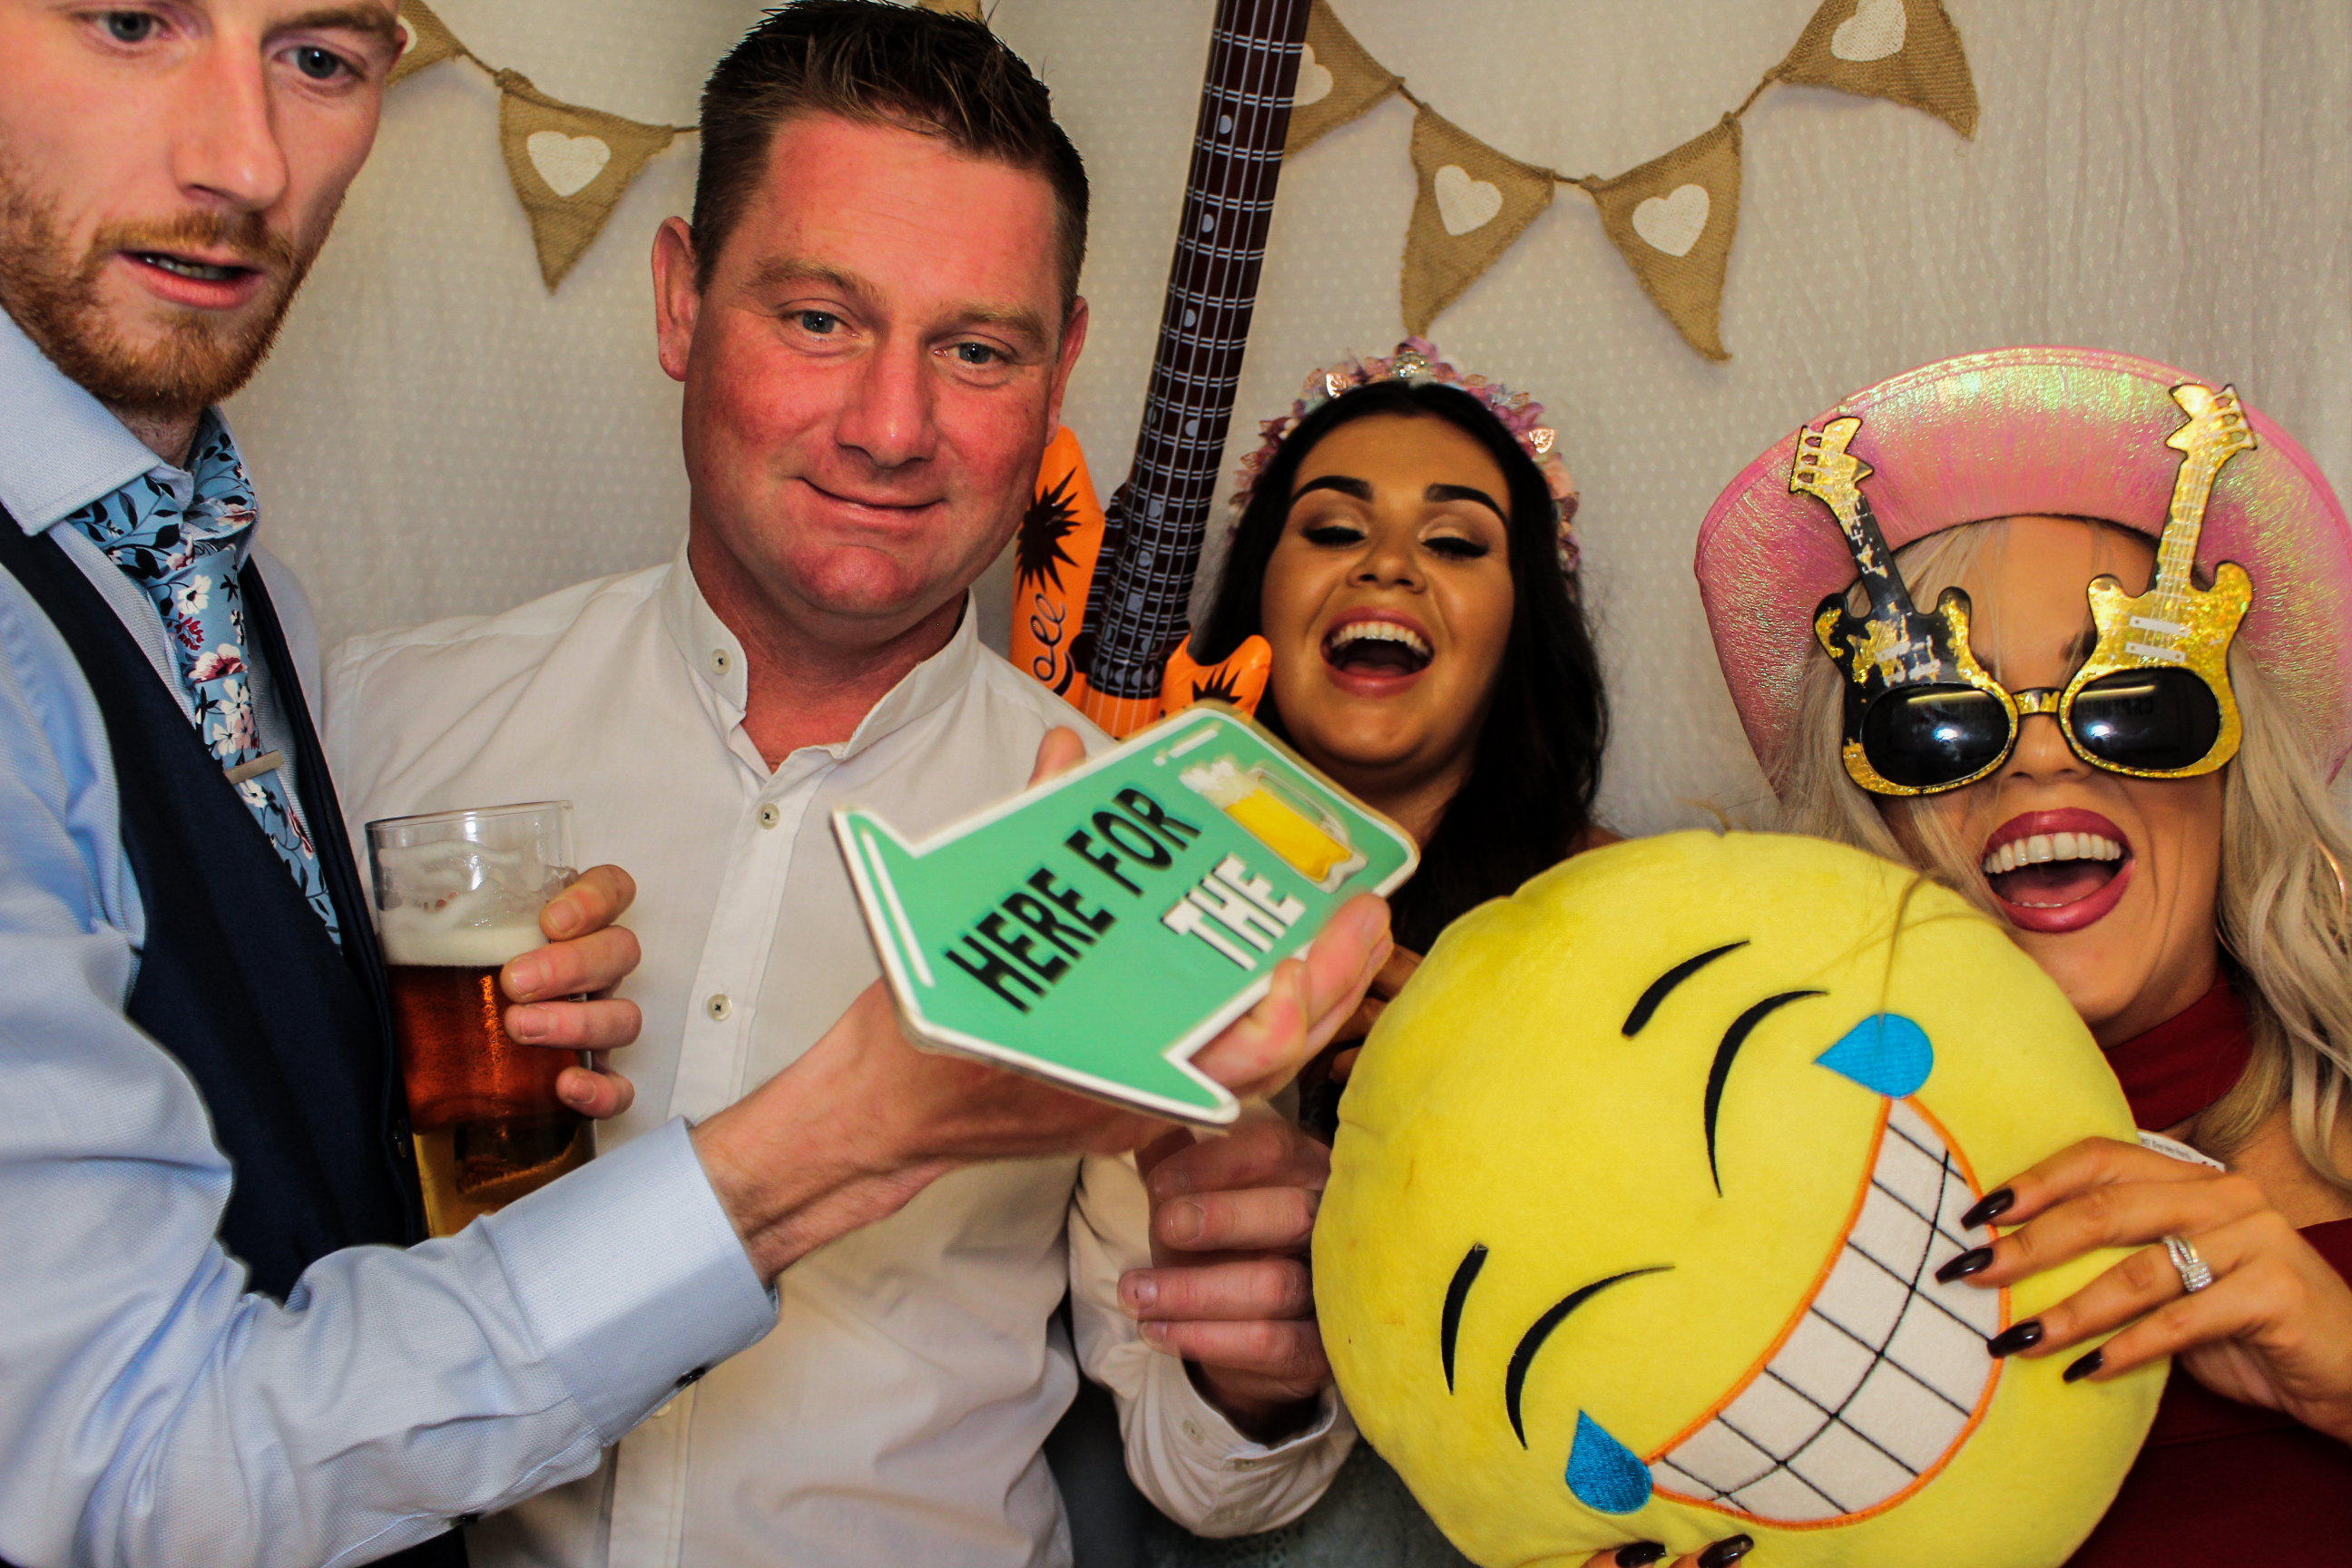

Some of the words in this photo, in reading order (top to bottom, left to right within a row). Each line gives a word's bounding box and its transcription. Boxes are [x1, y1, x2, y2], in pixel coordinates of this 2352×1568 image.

[1031, 593, 1073, 695] oll
[945, 868, 1117, 1014] HERE
[1065, 788, 1201, 897] FOR
[1161, 853, 1306, 971] THE
